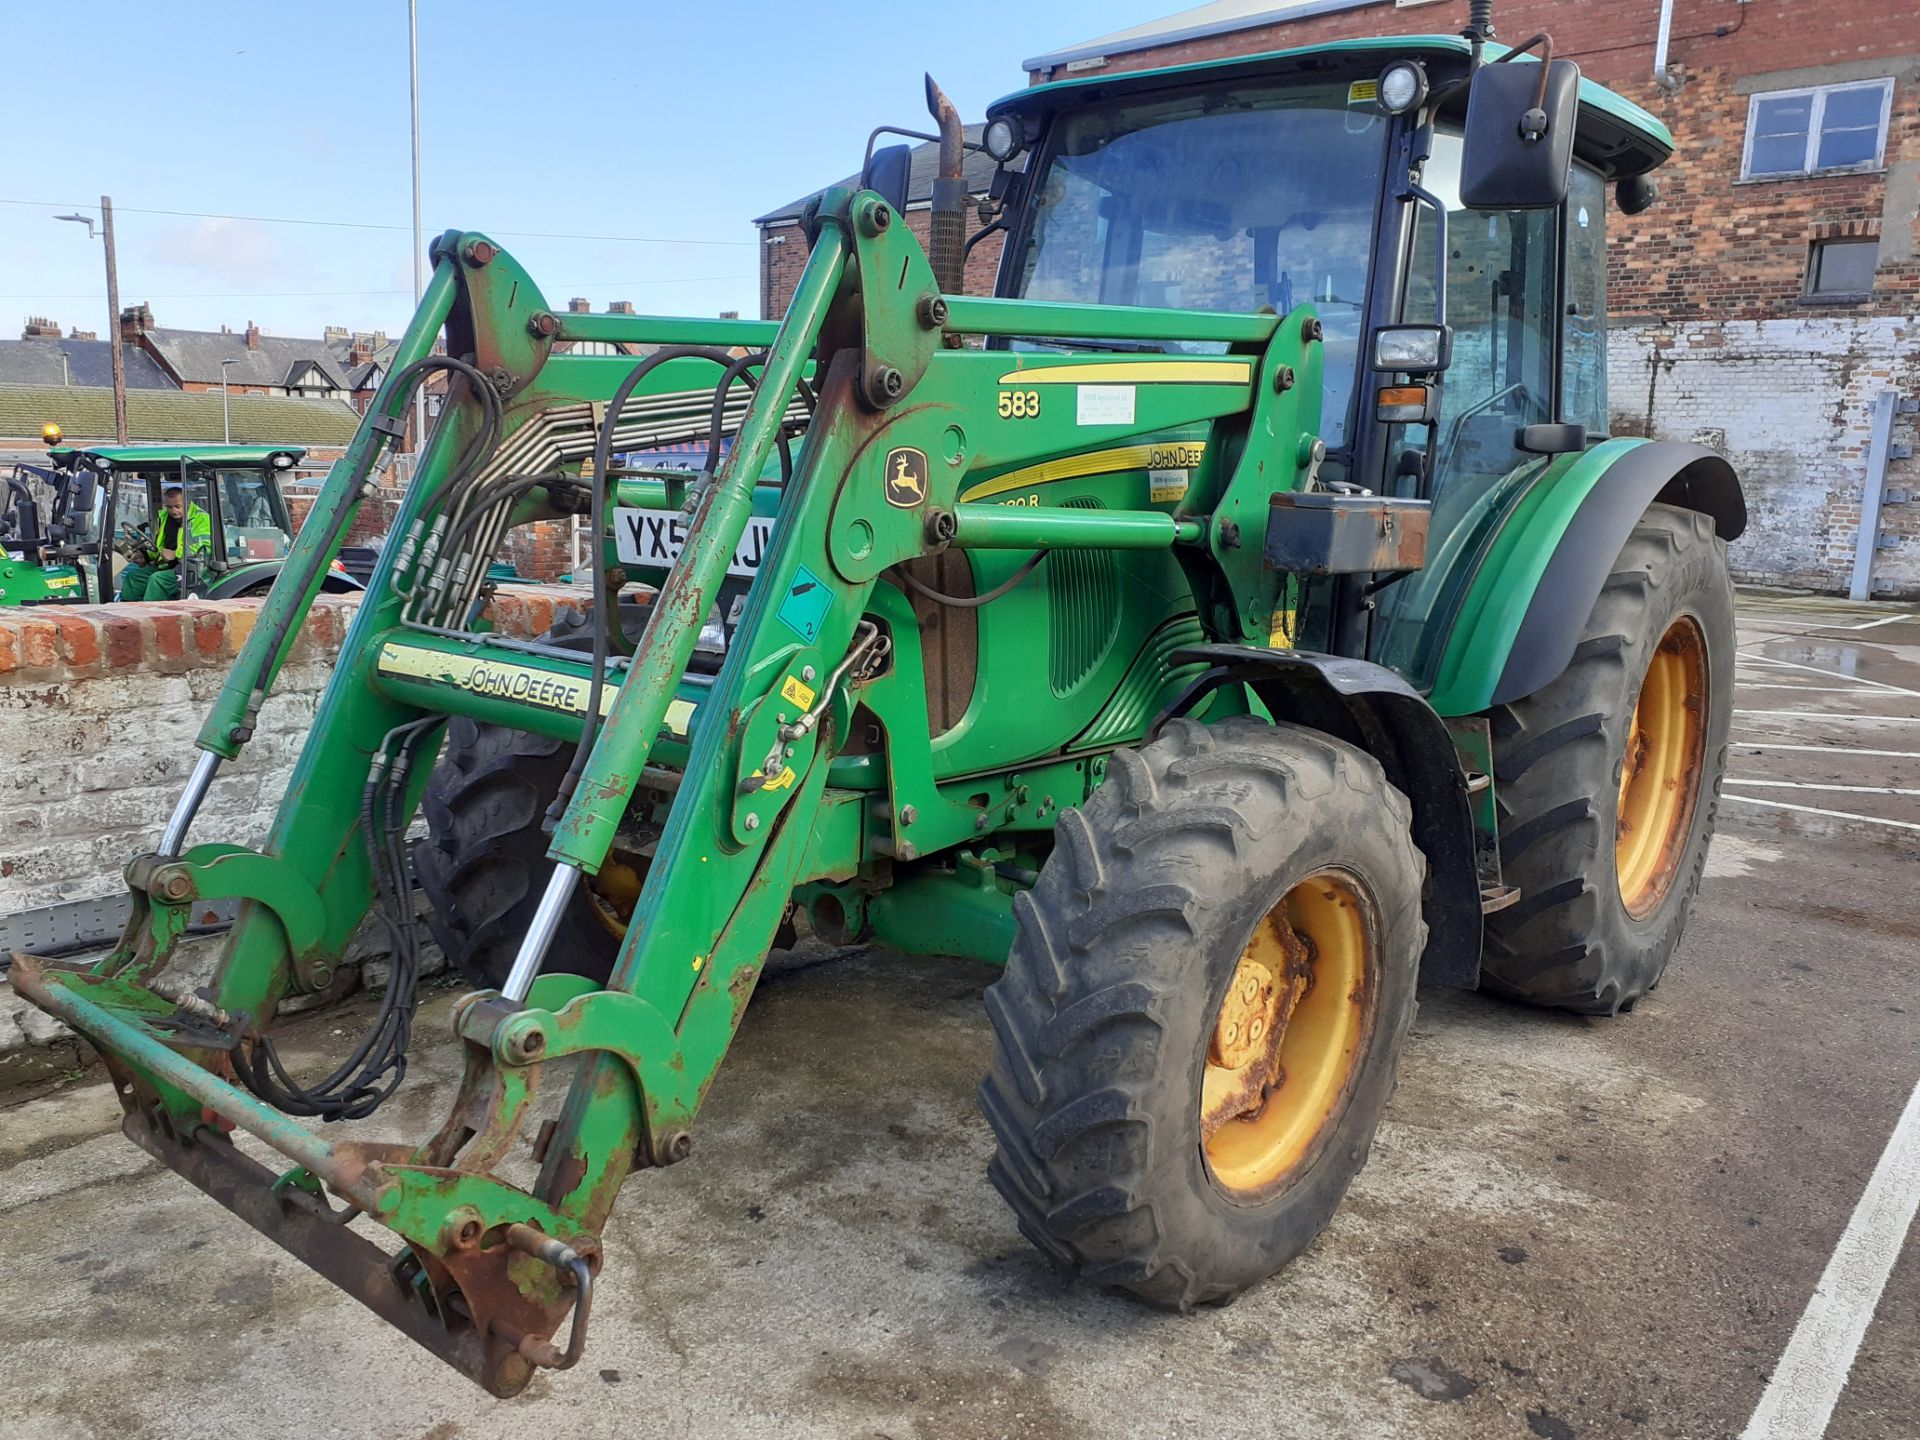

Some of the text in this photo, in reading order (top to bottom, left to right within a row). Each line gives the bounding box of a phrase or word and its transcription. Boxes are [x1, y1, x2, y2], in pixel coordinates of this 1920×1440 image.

[998, 390, 1040, 419] 583
[1147, 447, 1178, 467] JOHN
[806, 621, 814, 636] 2
[461, 664, 580, 708] JOHN DEERE
